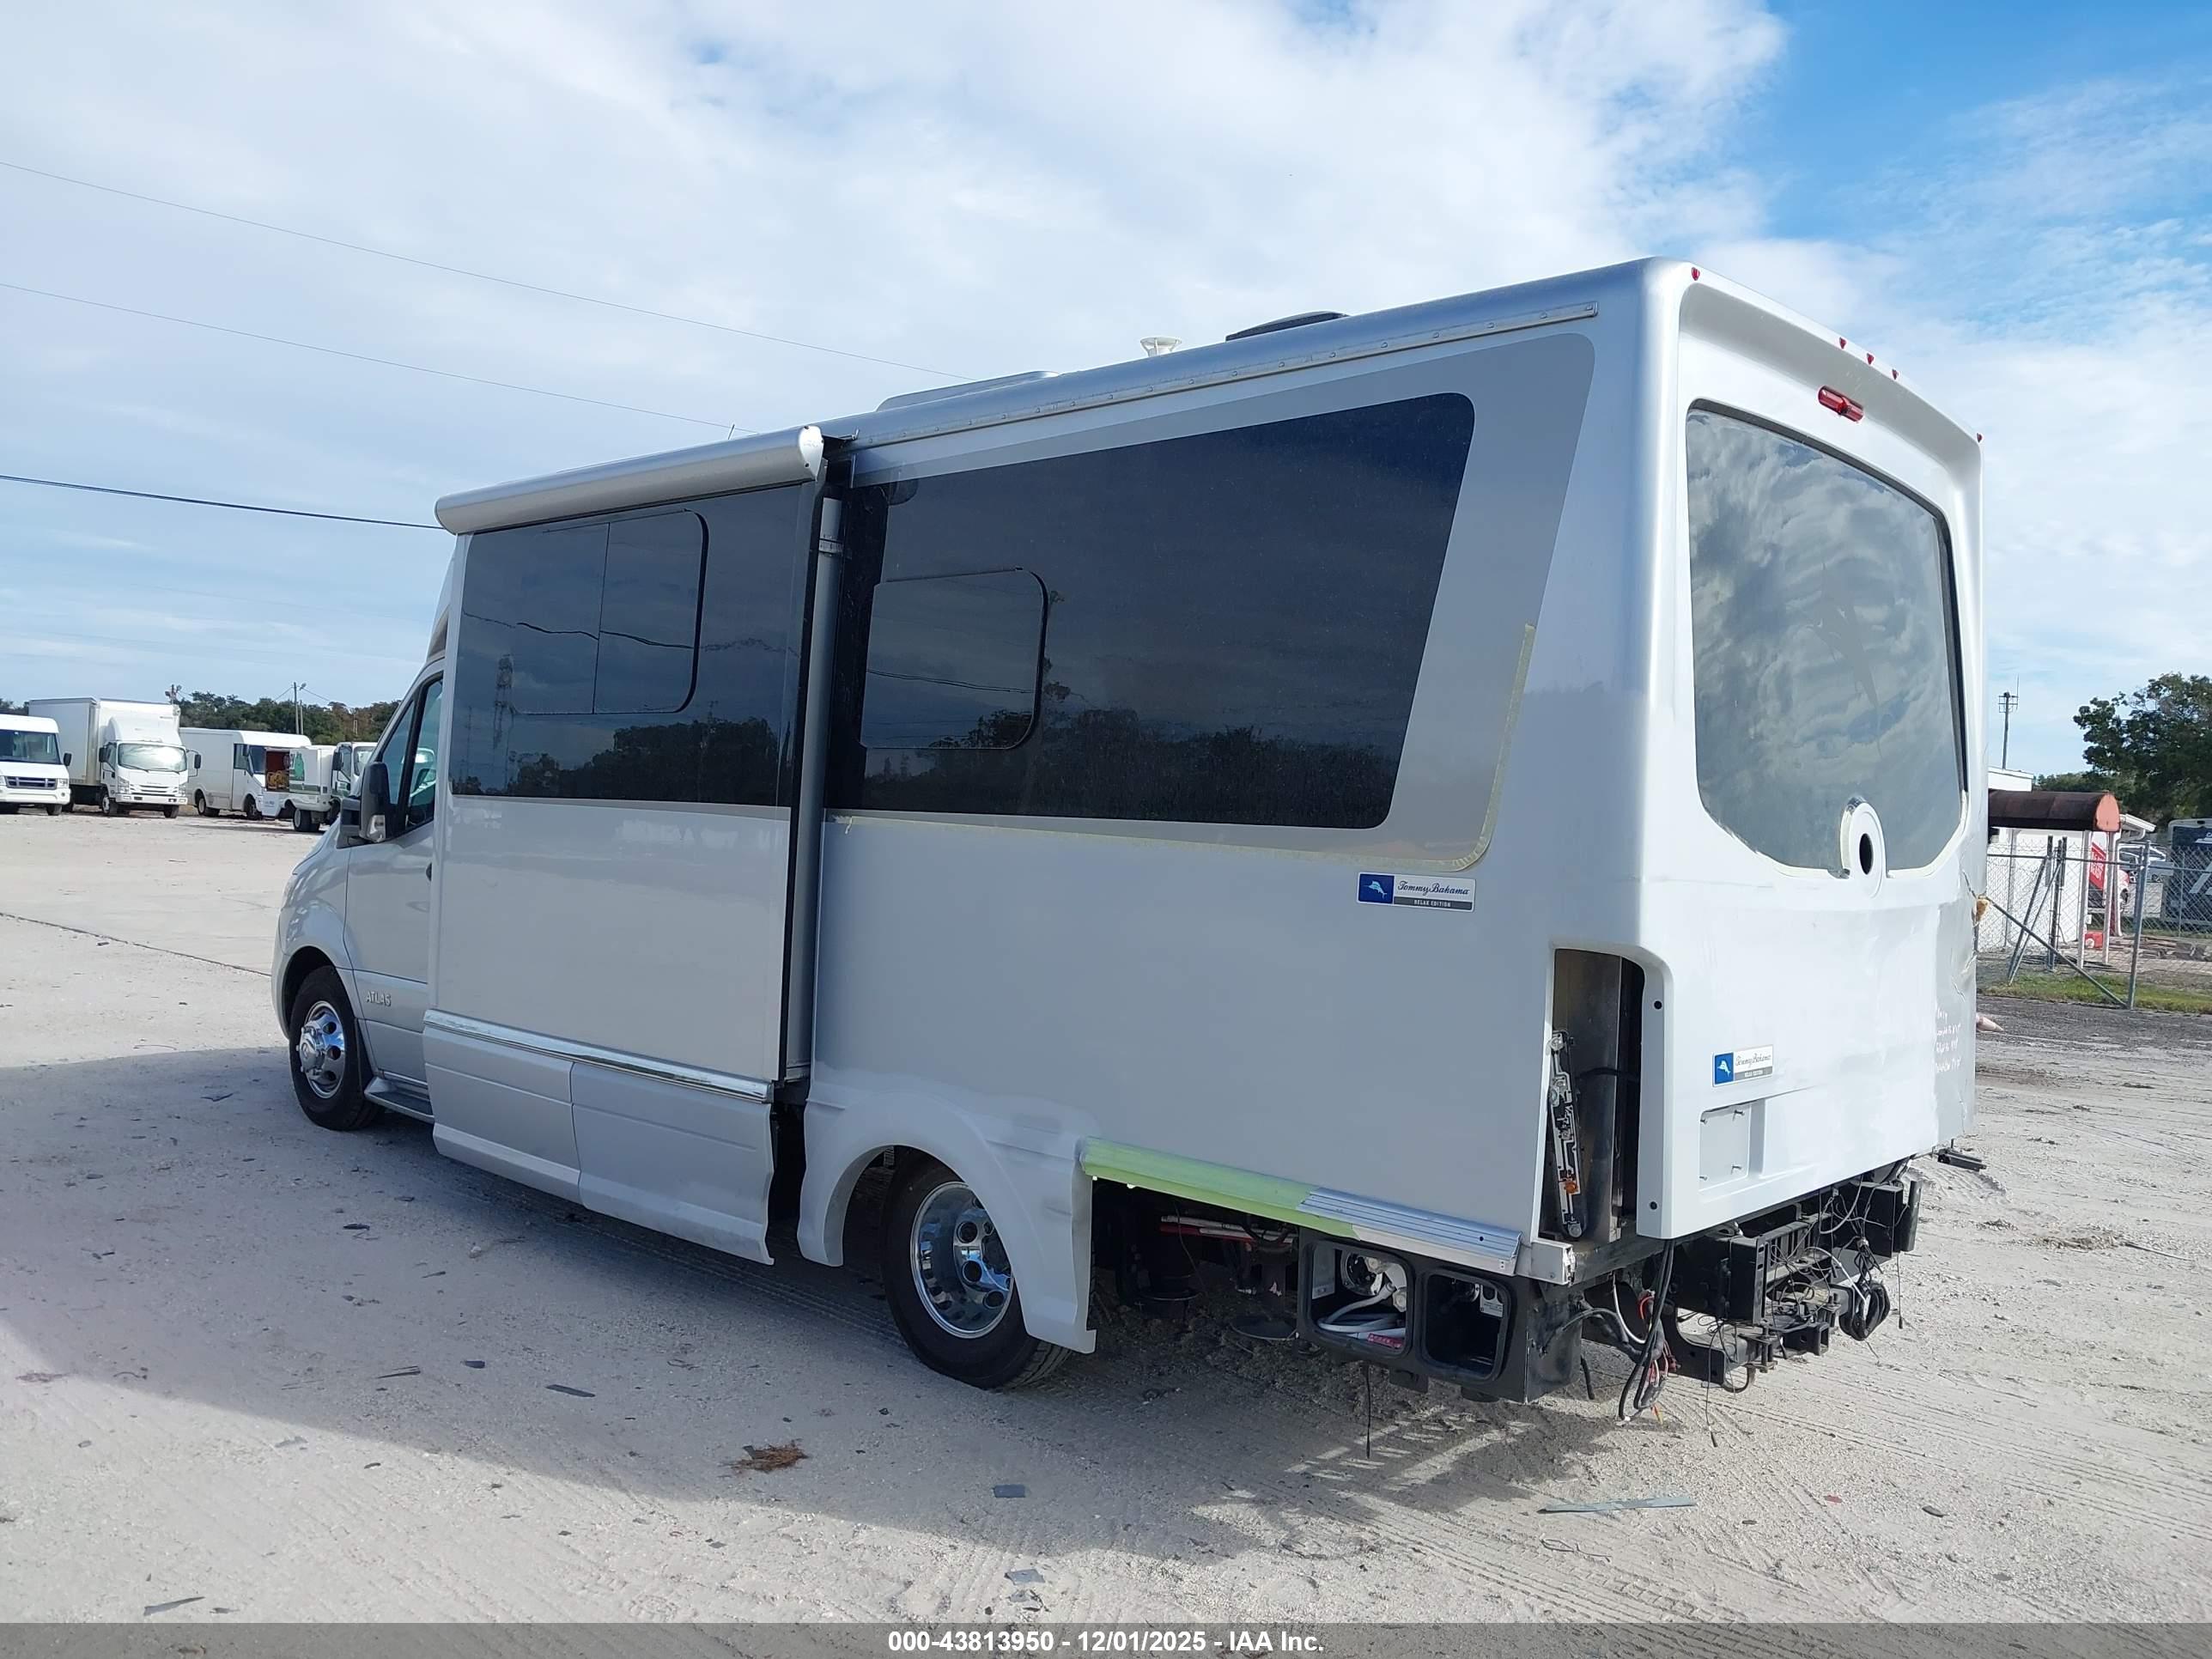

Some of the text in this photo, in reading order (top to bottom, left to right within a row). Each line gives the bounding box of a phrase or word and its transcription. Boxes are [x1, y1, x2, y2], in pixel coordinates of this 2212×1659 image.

[1397, 880, 1470, 896] Tommy Bahama
[366, 990, 392, 1007] ATLAS
